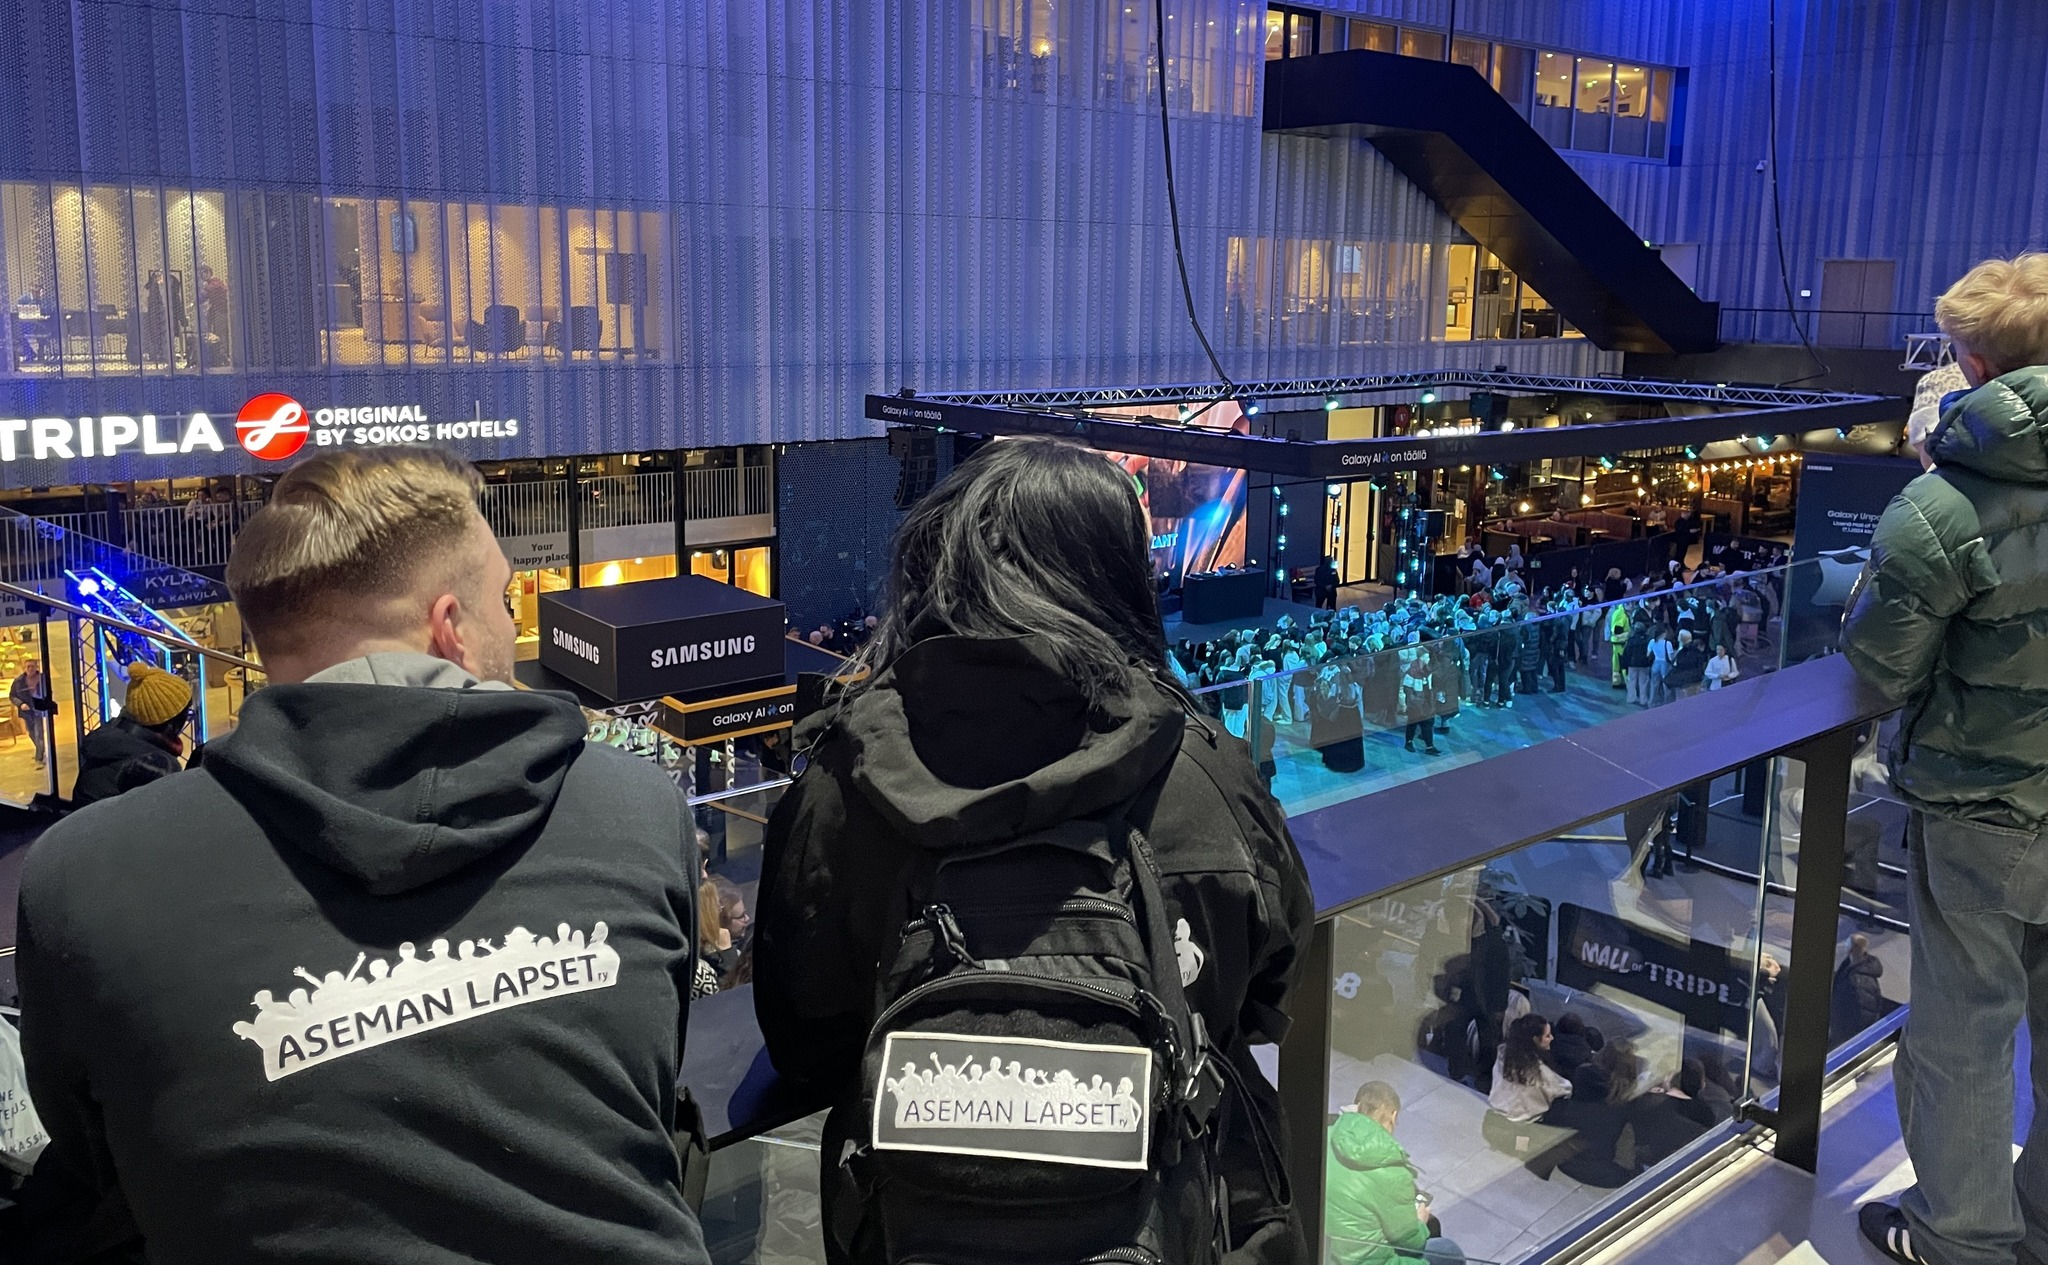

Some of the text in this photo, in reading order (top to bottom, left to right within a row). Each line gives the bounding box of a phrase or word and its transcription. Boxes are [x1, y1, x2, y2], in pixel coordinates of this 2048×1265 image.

[315, 405, 428, 426] ORIGINAL
[882, 405, 902, 418] Galaxy
[903, 408, 909, 416] AI
[0, 413, 225, 462] TRIPLA
[316, 419, 518, 446] BY SOKOS HOTELS
[1341, 449, 1427, 467] Galaxy AI on täällä
[1828, 510, 1859, 521] Galaxy
[531, 543, 554, 552] Your
[513, 556, 543, 566] happy
[553, 627, 600, 665] SAMSUNG
[651, 635, 755, 668] SAMSUNG
[712, 703, 794, 726] Galaxy AI on
[1582, 940, 1632, 973] MALL
[1183, 971, 1191, 981] ry
[279, 954, 608, 1069] ASEMAN LAPSET ry
[904, 1100, 1128, 1128] ASEMAN LAPSET ry
